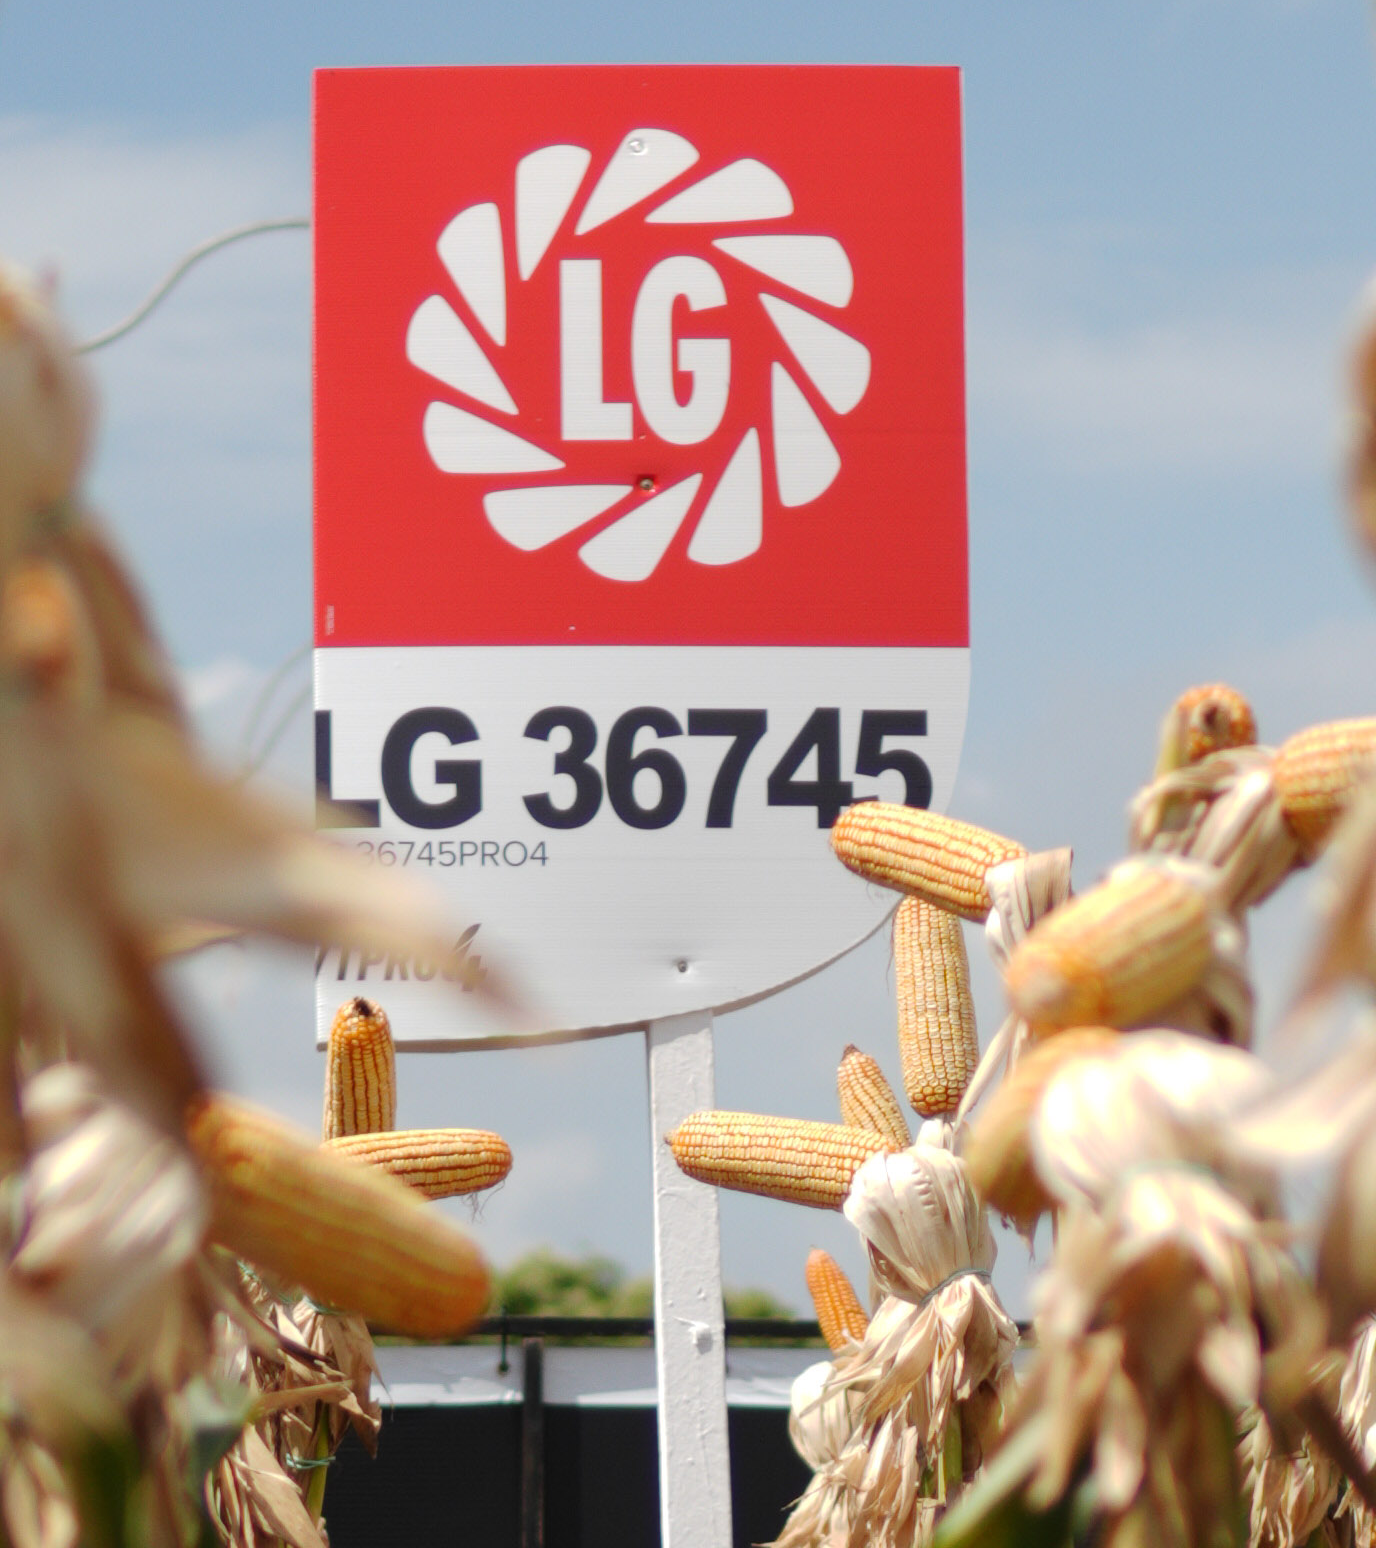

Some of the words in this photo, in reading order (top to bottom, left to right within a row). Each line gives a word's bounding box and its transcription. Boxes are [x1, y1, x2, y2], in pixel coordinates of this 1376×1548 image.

[559, 255, 731, 445] LG
[315, 706, 482, 829] LG
[522, 706, 933, 829] 36745
